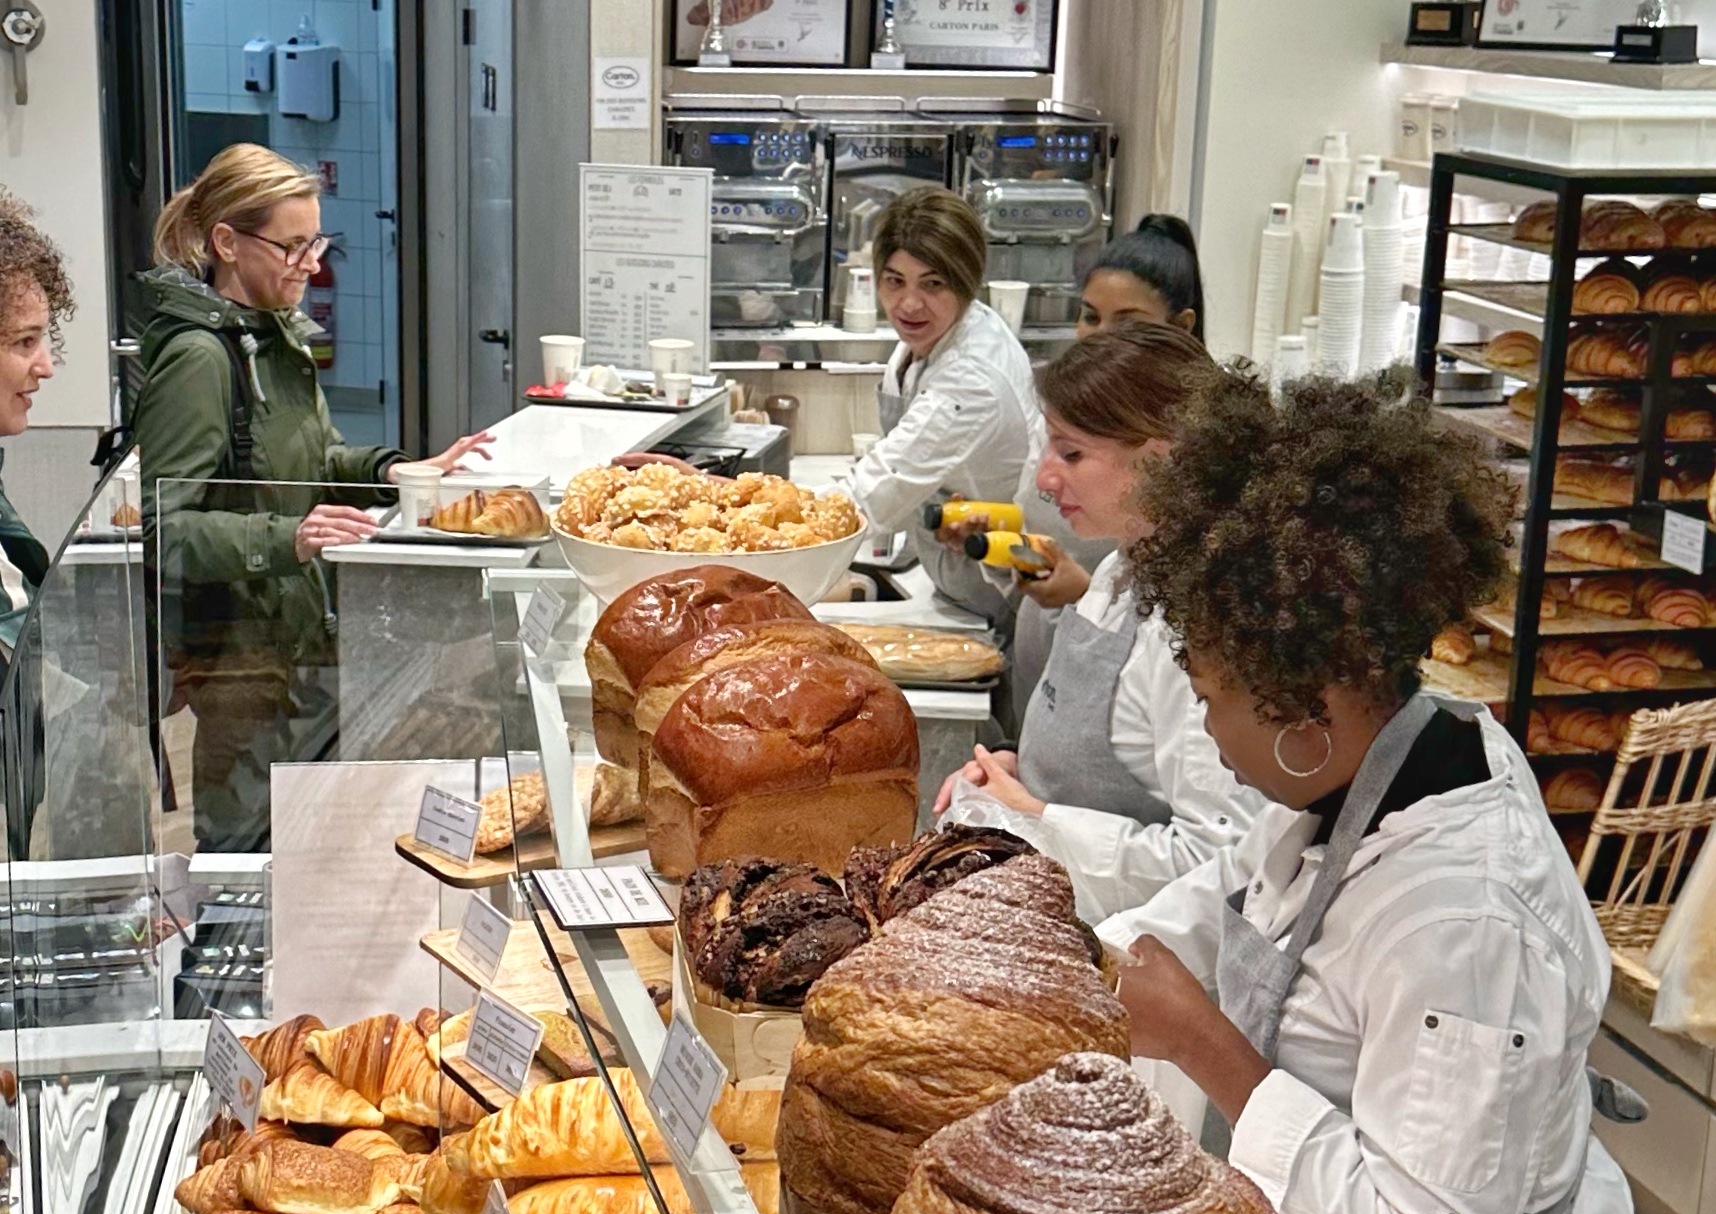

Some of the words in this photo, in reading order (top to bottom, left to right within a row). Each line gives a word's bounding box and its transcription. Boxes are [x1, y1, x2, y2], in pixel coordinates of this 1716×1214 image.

[929, 22, 970, 30] CARTON
[971, 23, 999, 31] PARIS
[848, 143, 933, 160] NESPRESSO
